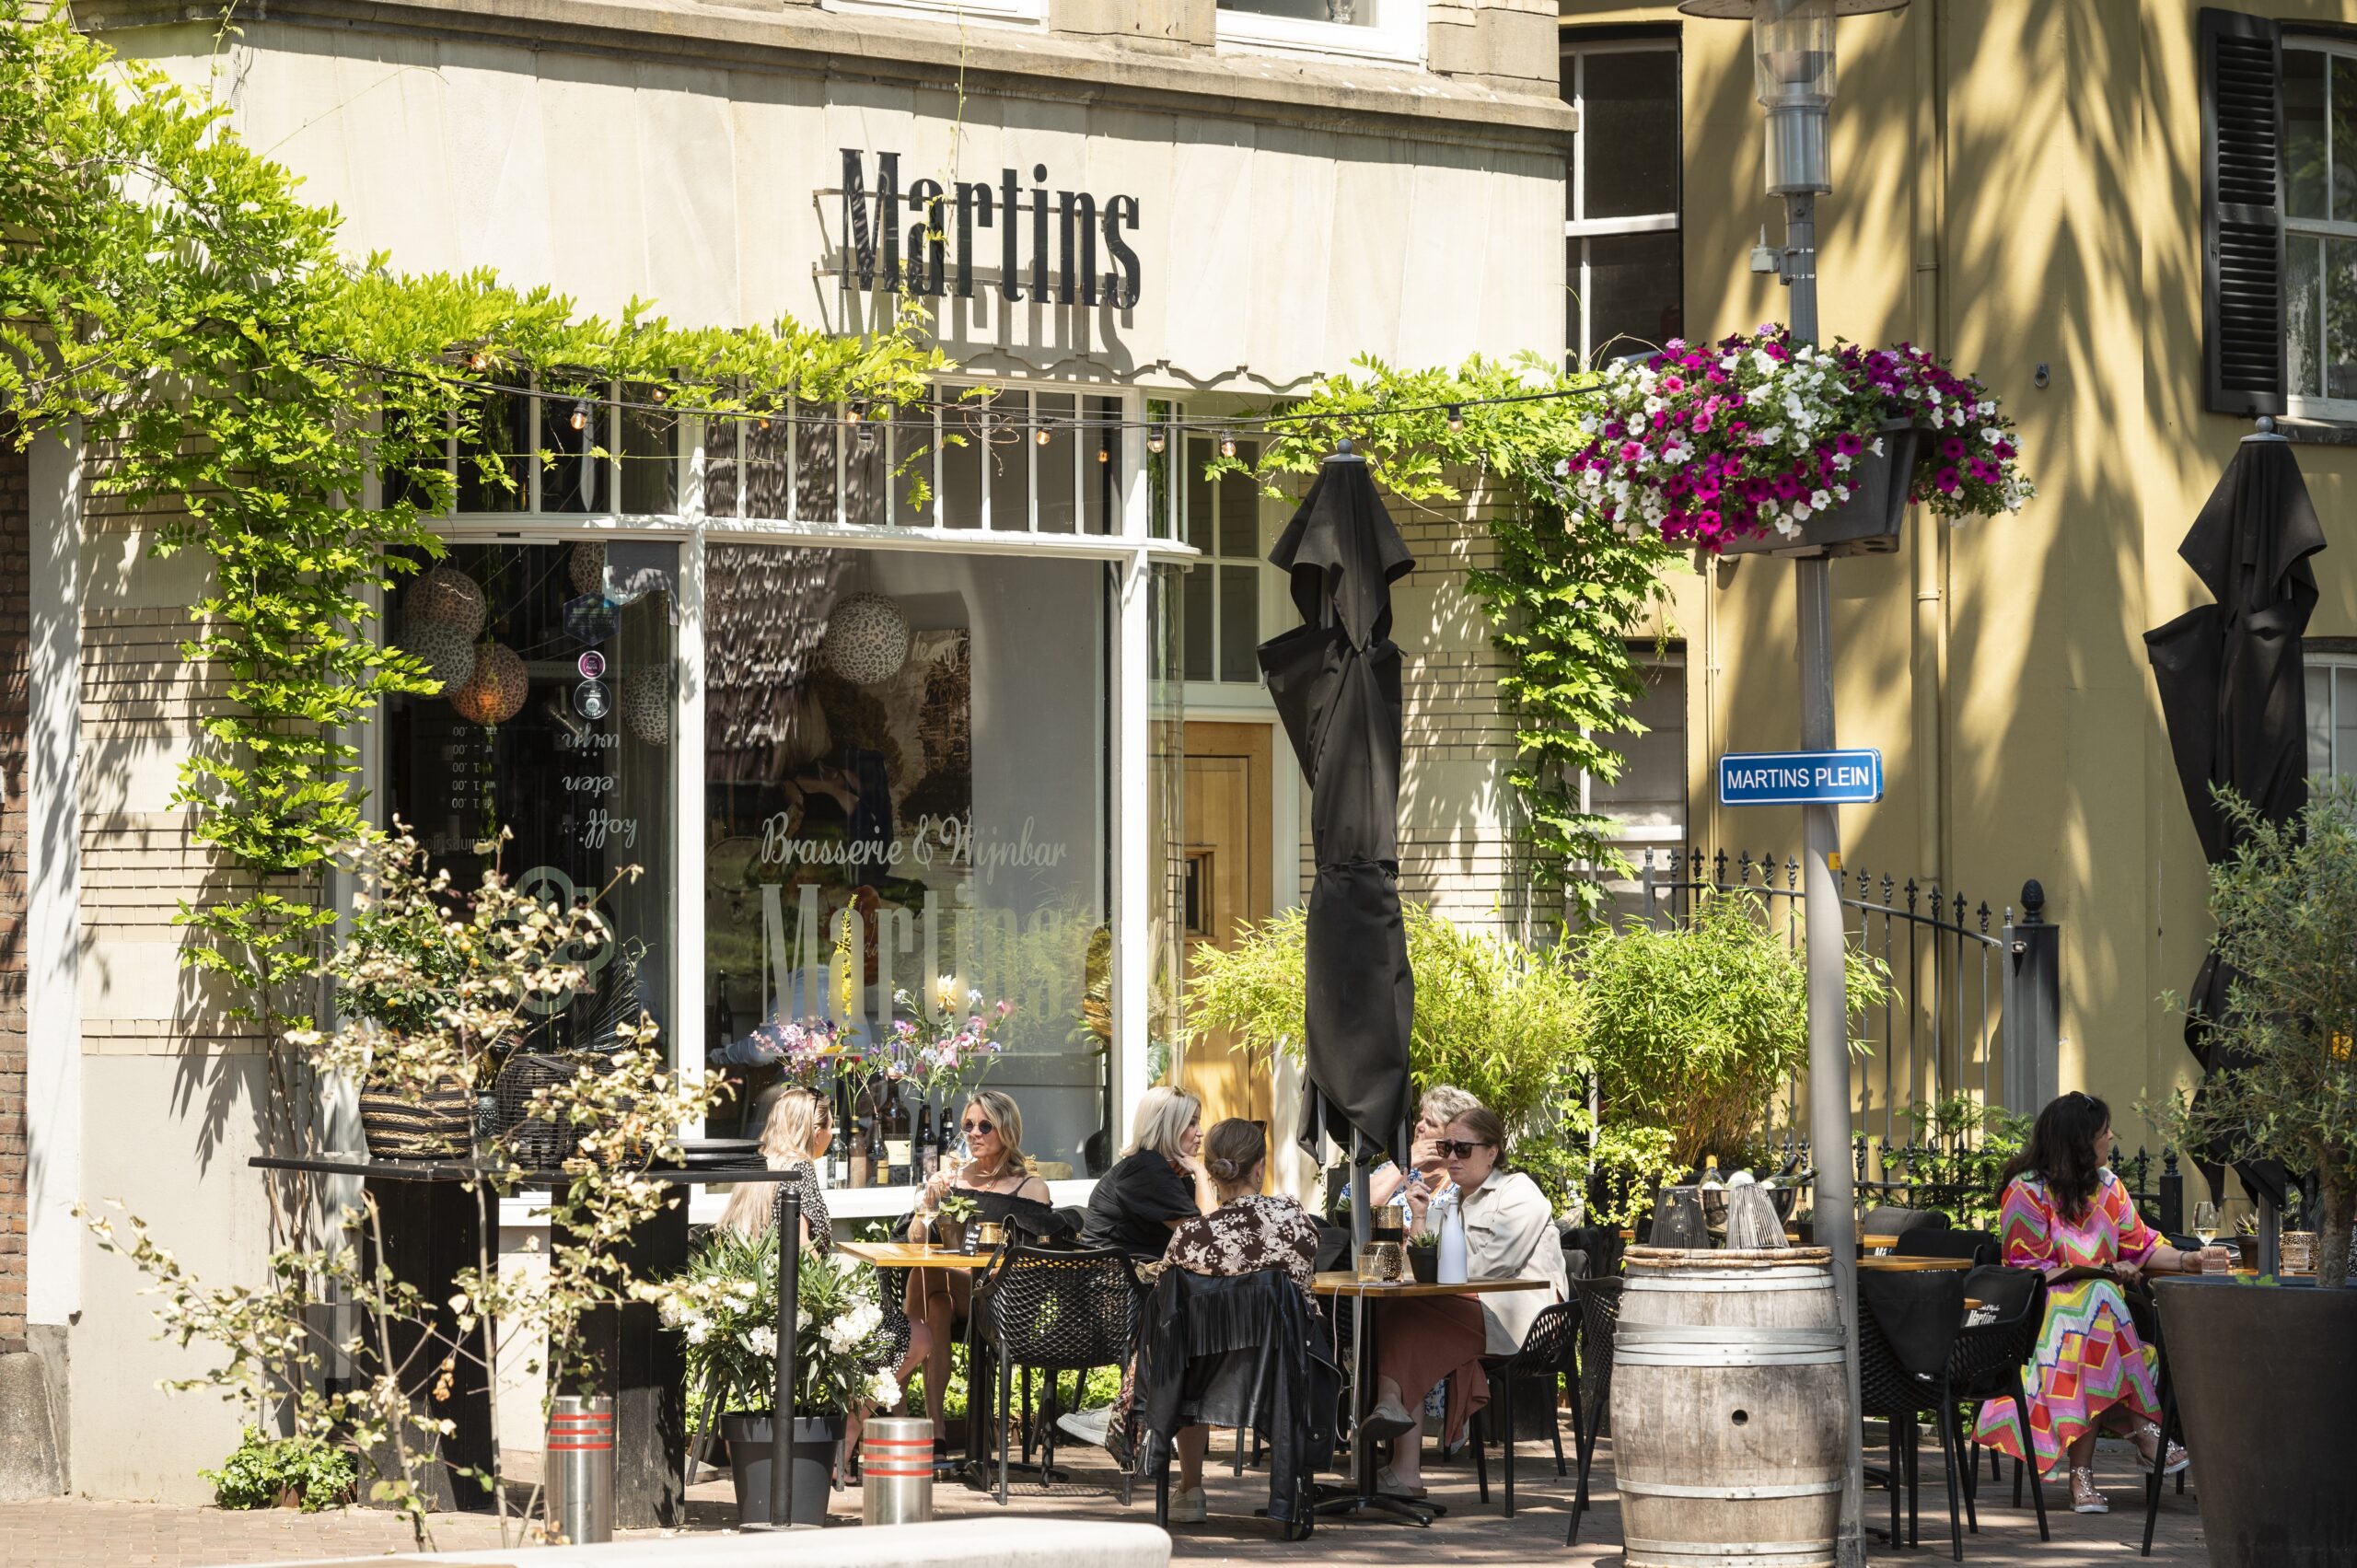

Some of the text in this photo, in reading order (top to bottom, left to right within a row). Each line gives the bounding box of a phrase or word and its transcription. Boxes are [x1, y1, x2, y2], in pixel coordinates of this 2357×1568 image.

[839, 147, 1141, 310] Martins
[562, 722, 620, 758] wijn
[562, 775, 614, 798] eten
[1726, 766, 1870, 790] MARTINS PLEIN
[761, 811, 1067, 886] Brasserie & Wijnbar
[759, 883, 1062, 1026] Martins
